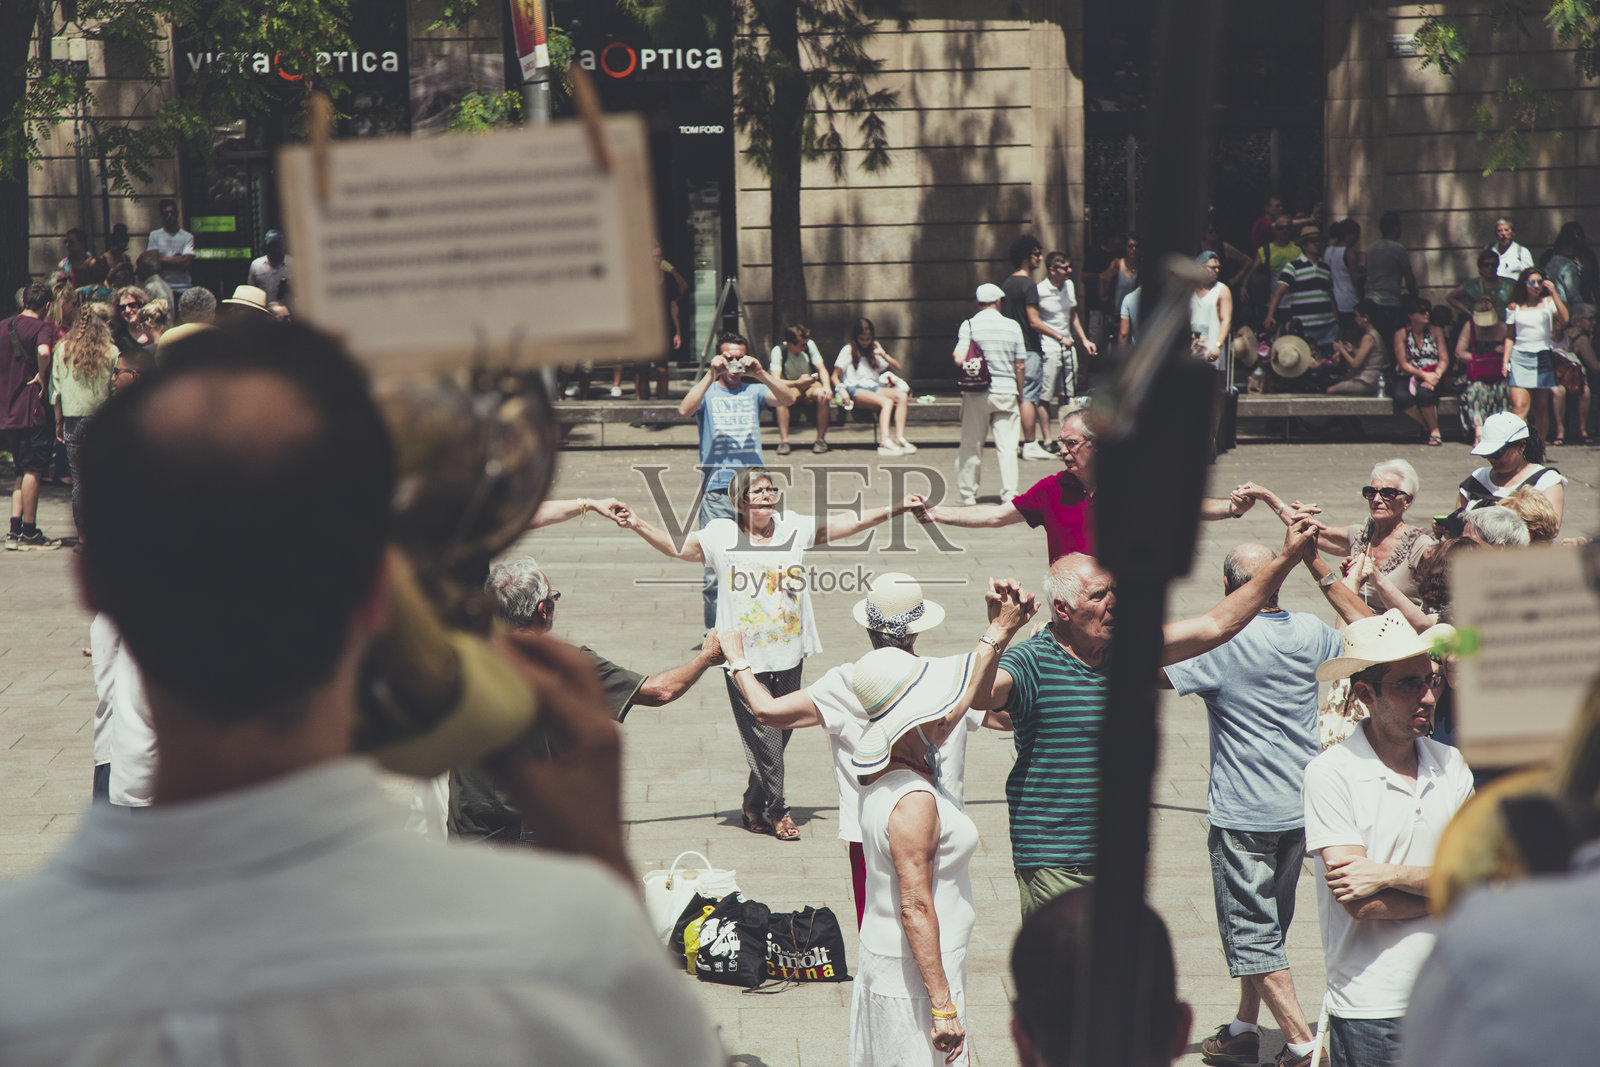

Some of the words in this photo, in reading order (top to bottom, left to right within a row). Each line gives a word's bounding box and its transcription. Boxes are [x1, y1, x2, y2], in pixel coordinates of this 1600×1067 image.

[678, 125, 698, 134] TOM
[699, 125, 725, 134] FORD
[765, 932, 782, 961] jo
